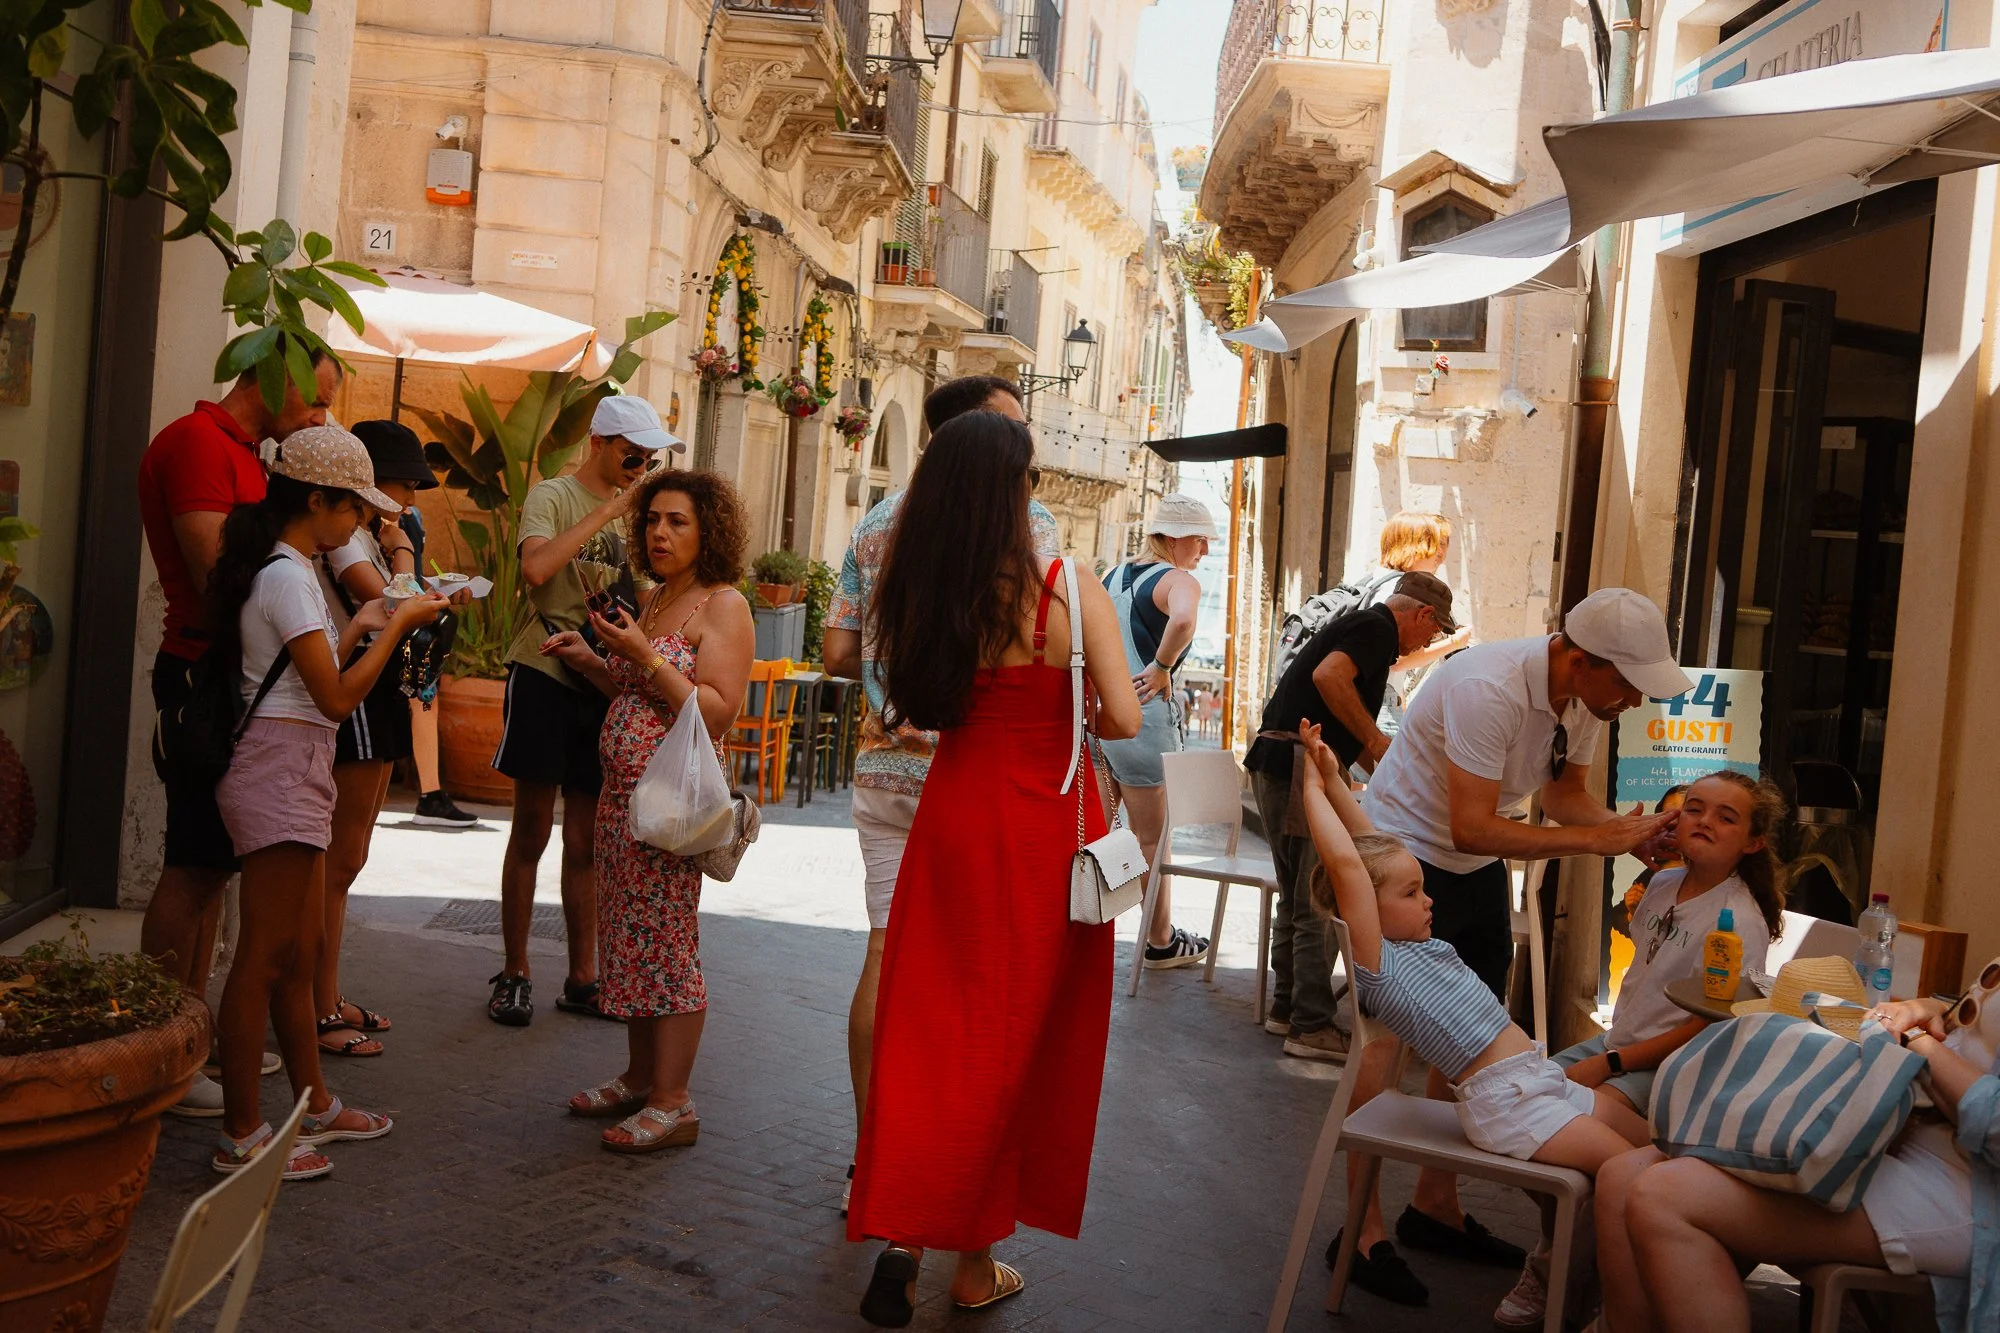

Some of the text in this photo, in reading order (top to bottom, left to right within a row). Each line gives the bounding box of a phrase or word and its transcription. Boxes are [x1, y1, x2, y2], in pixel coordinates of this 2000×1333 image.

[369, 228, 391, 250] 21
[1647, 719, 1733, 744] GUSTI
[1652, 744, 1684, 753] GELATO
[1691, 746, 1728, 755] GRANITE
[1651, 767, 1667, 776] 44
[1626, 778, 1638, 786] OF
[1641, 778, 1655, 786] ICE
